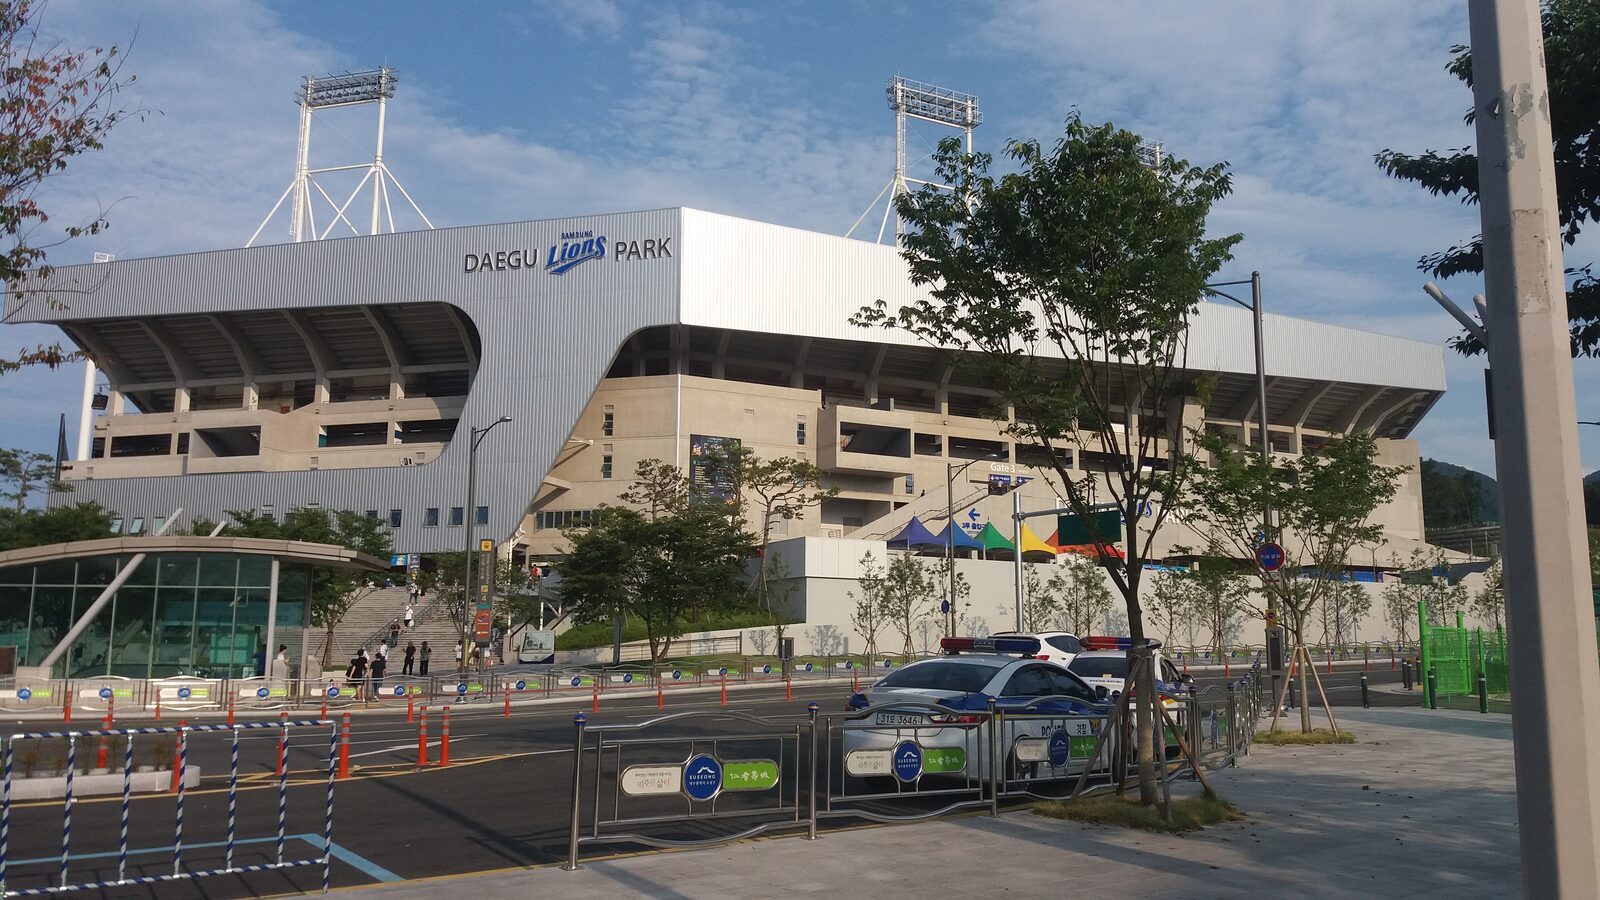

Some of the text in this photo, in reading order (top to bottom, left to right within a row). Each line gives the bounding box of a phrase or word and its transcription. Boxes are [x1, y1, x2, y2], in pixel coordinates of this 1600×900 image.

[561, 231, 593, 239] SAMSUNG
[465, 236, 672, 273] DAEGU Lions PARK
[990, 462, 1016, 473] Gate 3
[898, 715, 918, 725] 3646
